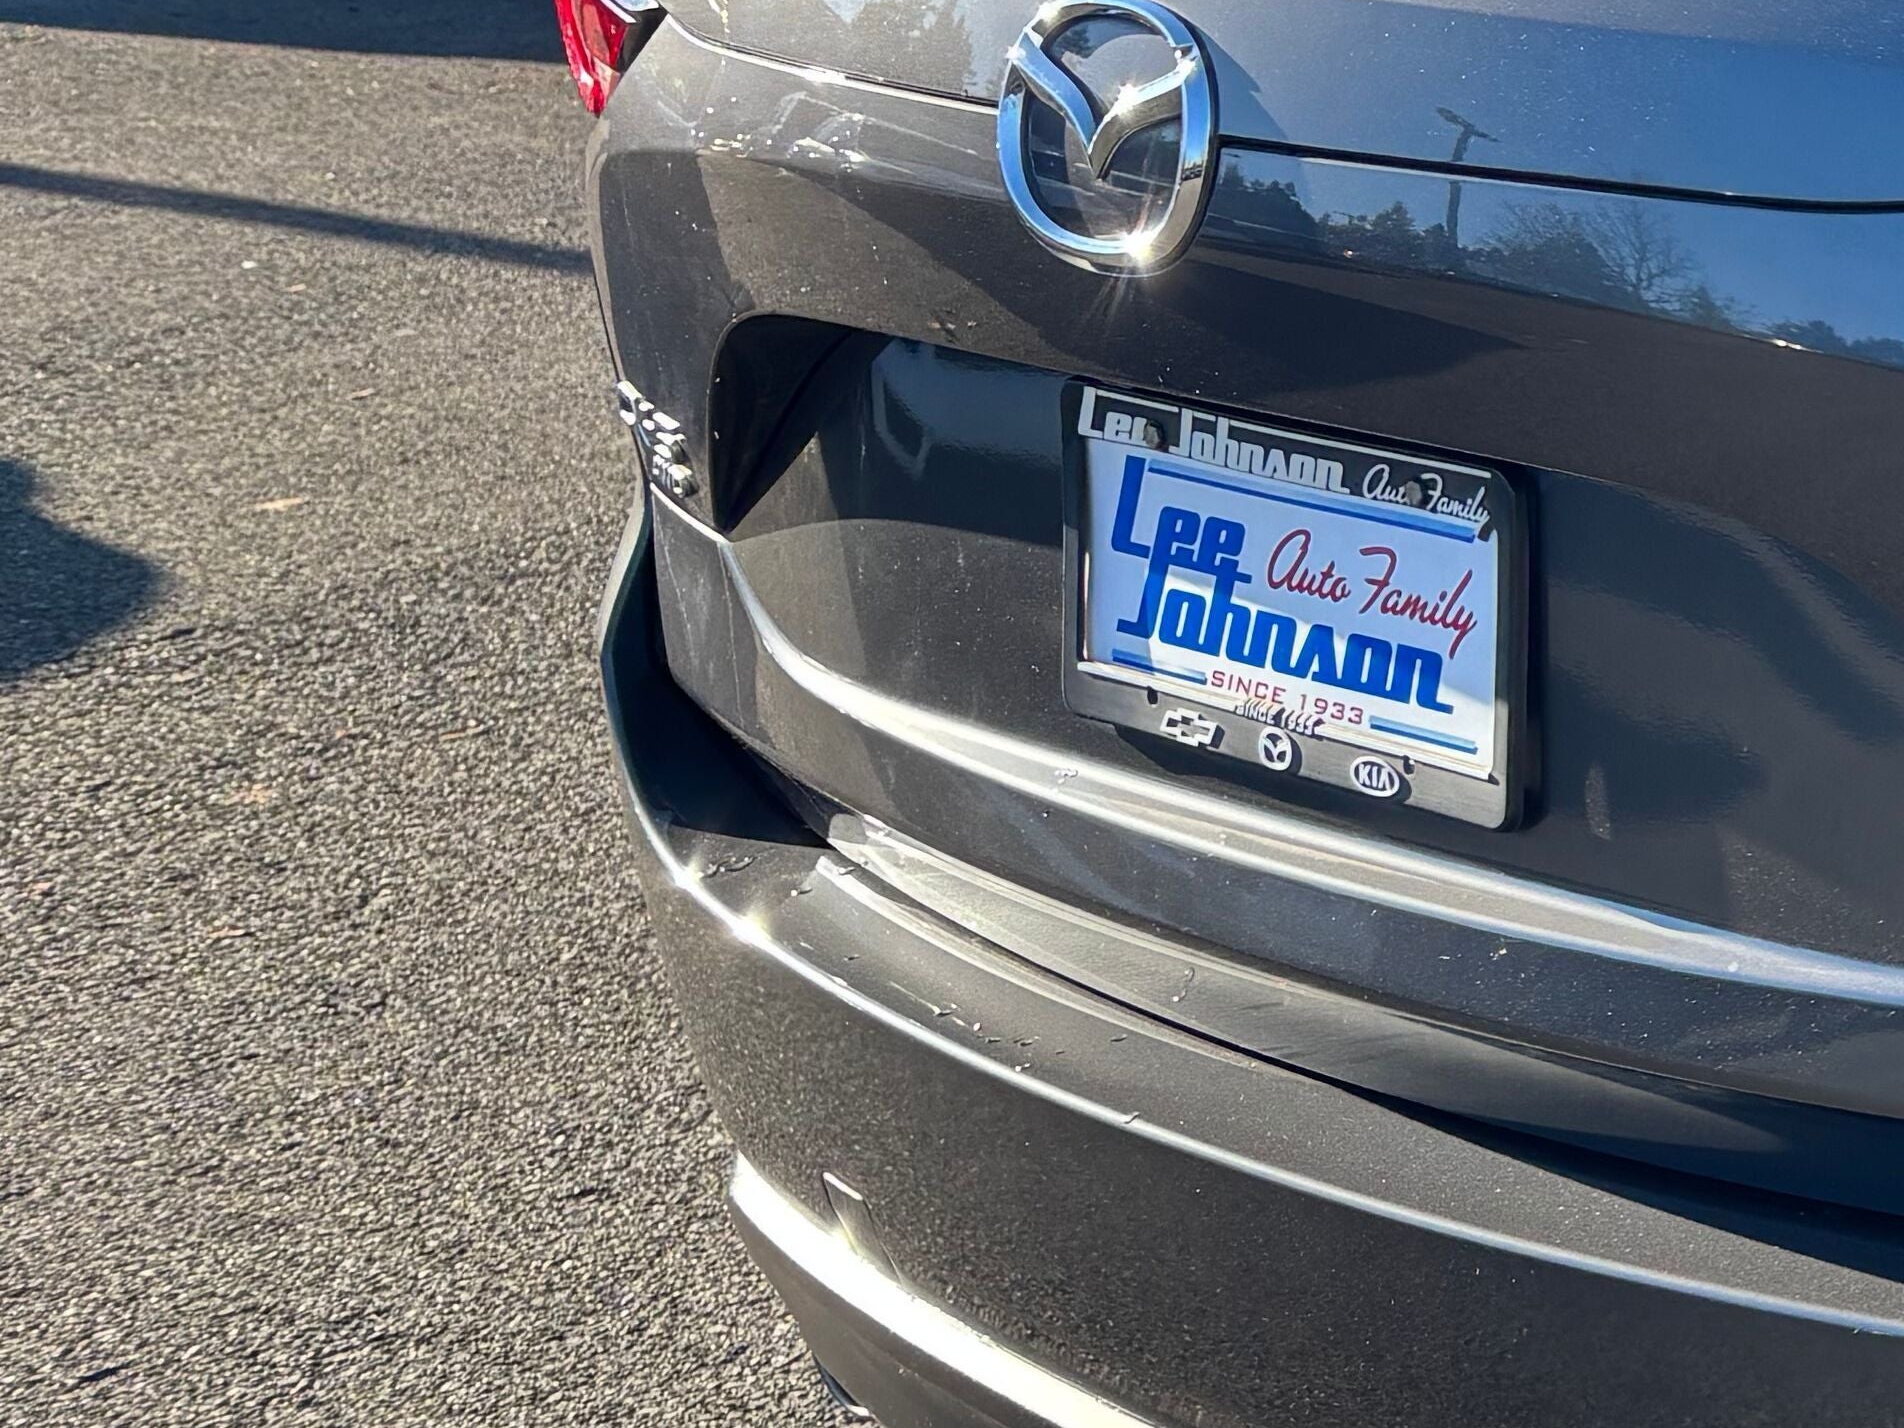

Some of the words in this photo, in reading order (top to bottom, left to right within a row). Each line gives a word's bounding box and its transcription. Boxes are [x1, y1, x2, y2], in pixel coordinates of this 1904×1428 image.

[1169, 408, 1350, 495] Johnson
[1362, 463, 1424, 506] Aut
[1421, 472, 1490, 525] Family
[1111, 455, 1246, 567] Lee
[1266, 529, 1352, 602] Auto
[1359, 546, 1478, 659] Family
[1116, 559, 1453, 714] Johnson
[1211, 670, 1287, 705] SINCE
[1300, 693, 1364, 724] 1933
[1357, 762, 1393, 793] KIA
